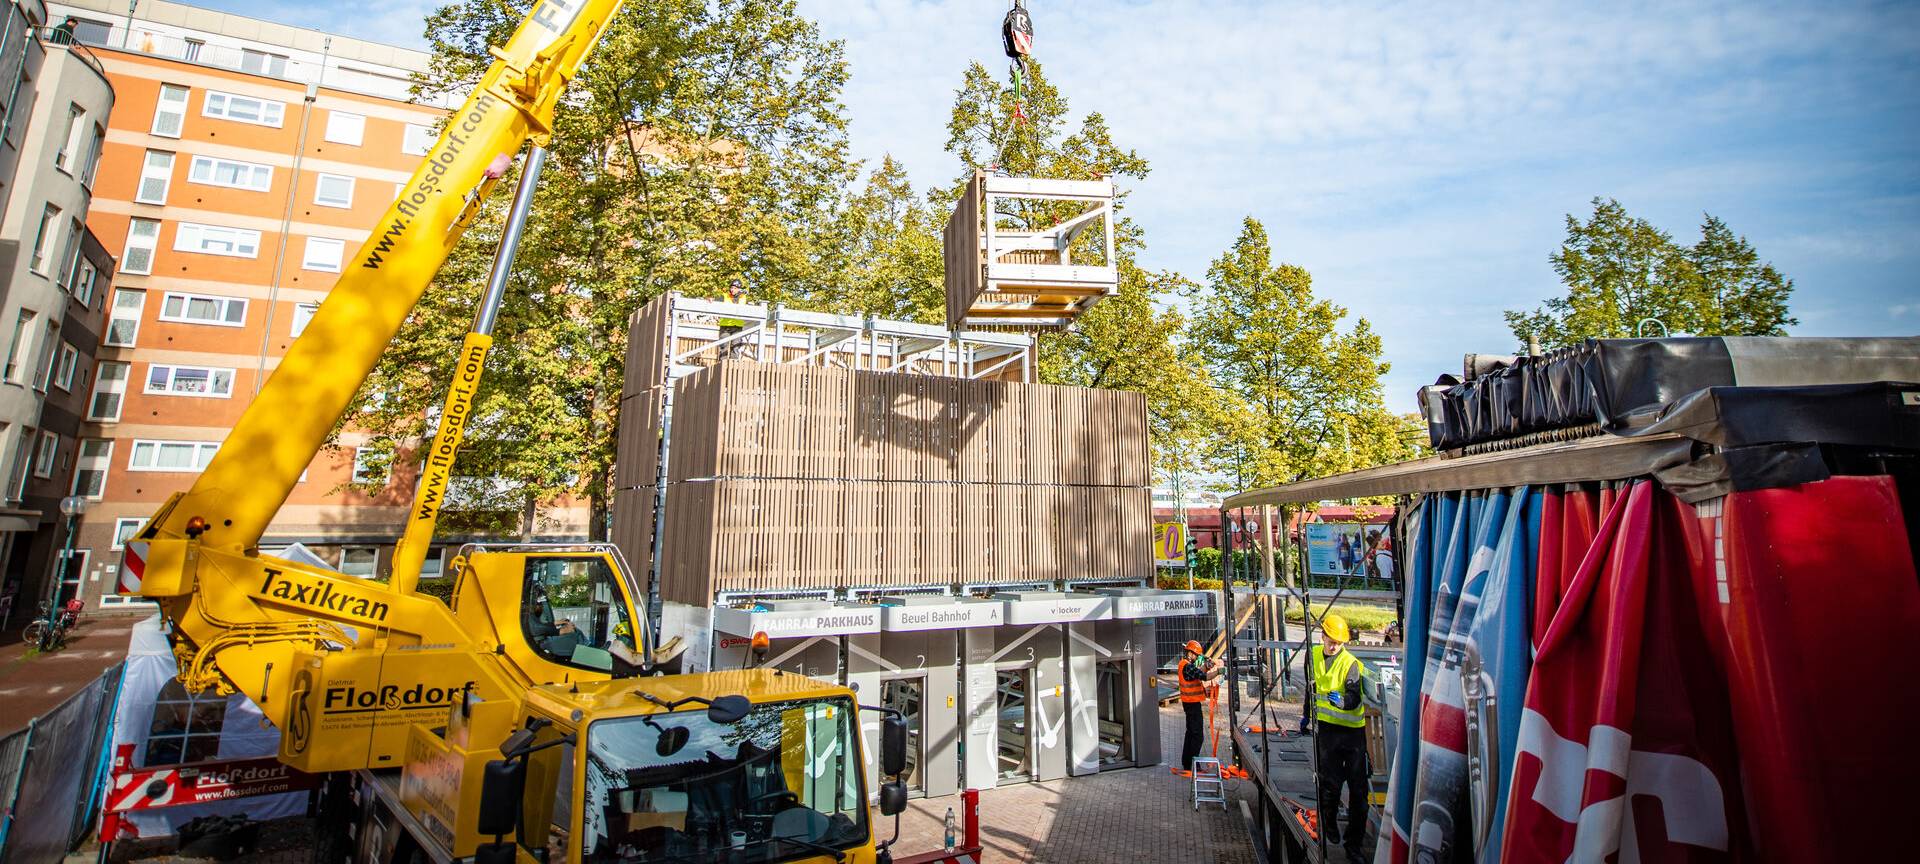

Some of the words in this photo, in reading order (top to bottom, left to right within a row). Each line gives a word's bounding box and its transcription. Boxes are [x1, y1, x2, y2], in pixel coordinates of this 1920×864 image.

[363, 94, 496, 270] www.flossdorf.com
[418, 345, 483, 520] www.flossdorf.com
[258, 567, 390, 622] Taxikran
[1128, 600, 1204, 612] FAHRRADPARKHAUS
[763, 615, 875, 632] FAHRRADPARKHAUS
[901, 612, 929, 624] Beuel
[931, 609, 972, 622] Bahnhof
[990, 609, 998, 620] A
[1026, 647, 1036, 663] 3
[1123, 639, 1132, 655] 4
[916, 655, 926, 670] 2
[197, 764, 288, 785] Floßdorf
[195, 783, 289, 801] www.flossdorf.com
